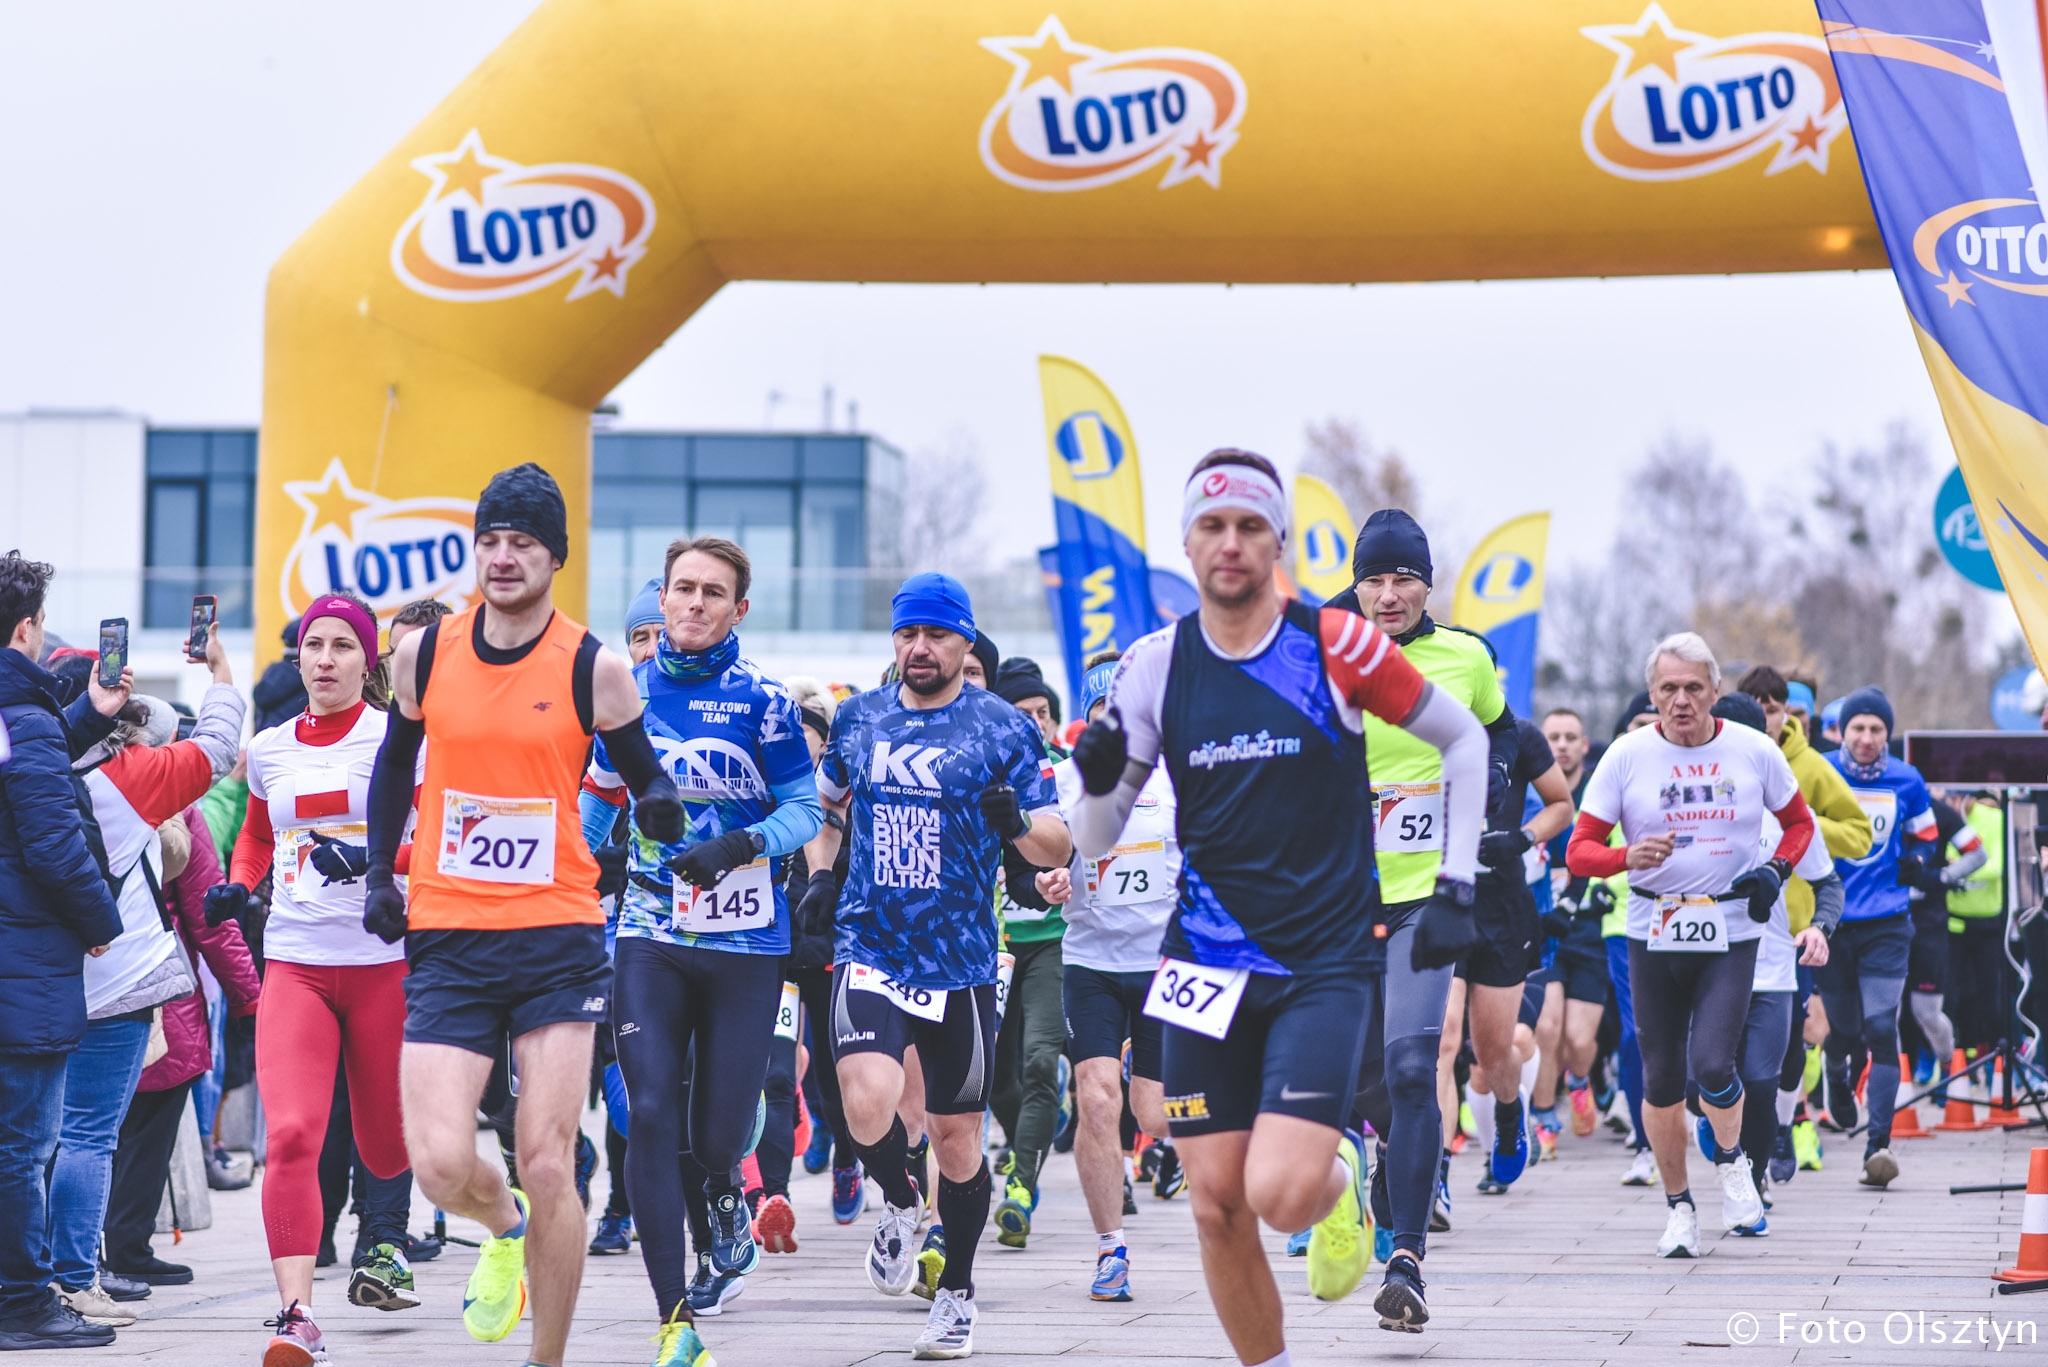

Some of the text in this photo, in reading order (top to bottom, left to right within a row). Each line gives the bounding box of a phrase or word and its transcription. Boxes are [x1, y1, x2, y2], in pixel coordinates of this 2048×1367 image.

[1038, 81, 1187, 155] LOTTO
[1643, 66, 1795, 143] LOTTO
[451, 198, 596, 264] LOTTO
[324, 532, 466, 597] LOTTO
[688, 699, 751, 714] NIKIELKOWO
[701, 712, 730, 724] TEAM
[880, 785, 942, 799] KRISS COACHING
[872, 803, 940, 828] SWIM
[1399, 813, 1433, 842] 52
[1663, 809, 1735, 823] ANDRZEJ
[873, 821, 941, 851] BIKE
[470, 835, 540, 869] 207
[873, 843, 941, 874] RUN
[874, 867, 941, 890] ULTRA
[1115, 869, 1149, 895] 73
[704, 887, 760, 920] 145
[1671, 920, 1717, 942] 120
[1161, 969, 1224, 1013] 367
[776, 1006, 792, 1027] 8
[837, 1031, 876, 1047] HUUB
